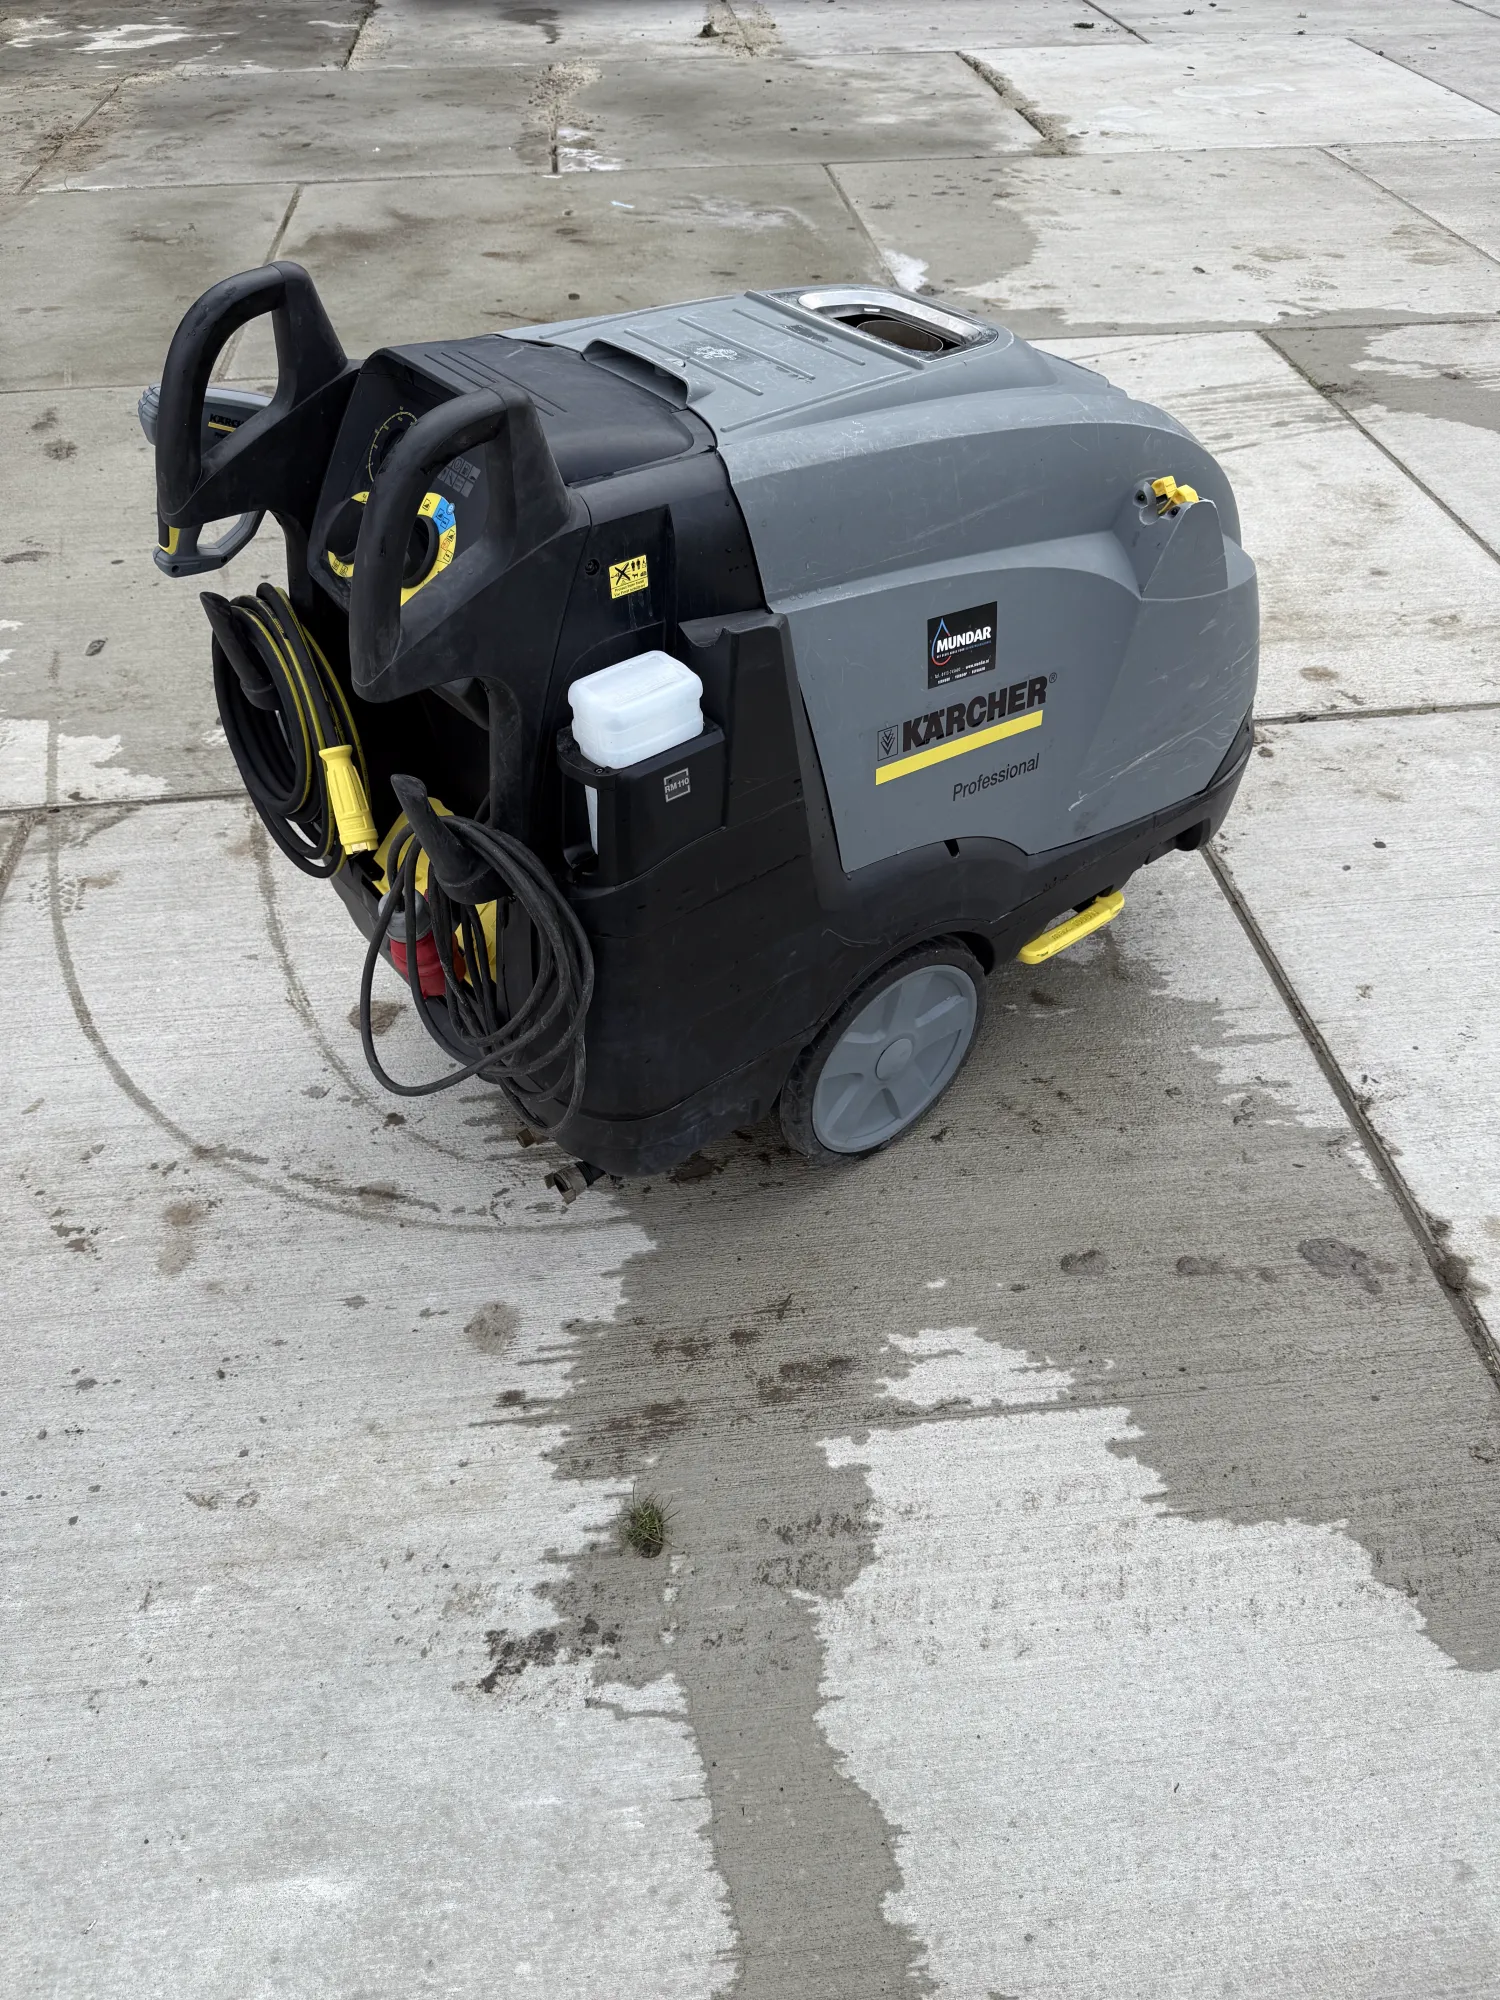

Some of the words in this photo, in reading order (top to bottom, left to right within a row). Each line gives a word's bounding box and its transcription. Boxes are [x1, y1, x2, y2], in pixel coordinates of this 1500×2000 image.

[936, 626, 992, 653] MUNDAR
[665, 782, 678, 794] RM
[677, 777, 690, 788] 110
[952, 752, 1040, 802] Professional
